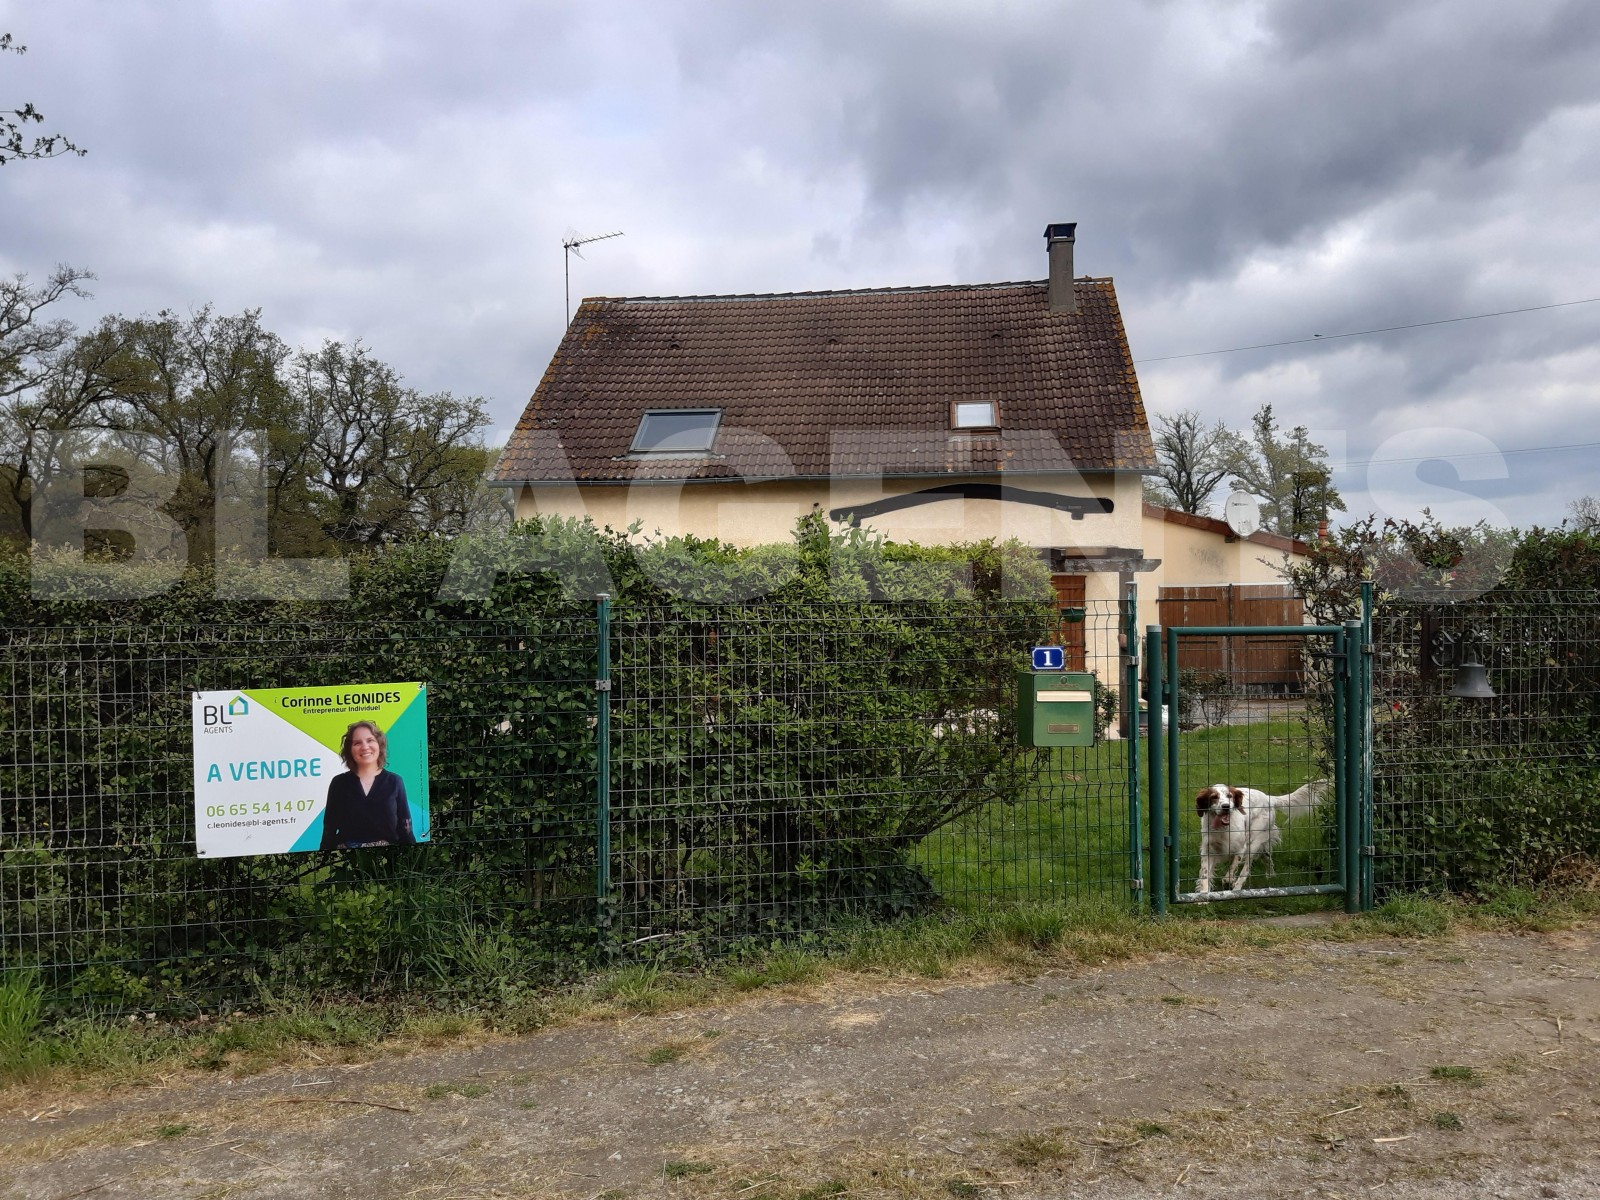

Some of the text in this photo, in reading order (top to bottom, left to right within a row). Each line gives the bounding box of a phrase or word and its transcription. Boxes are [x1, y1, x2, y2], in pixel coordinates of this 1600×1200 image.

[1043, 650, 1053, 666] 1
[281, 691, 401, 708] Corinne LEONIDES
[204, 705, 233, 726] BL
[303, 704, 381, 715] Entrepreneur Individuel
[204, 725, 233, 735] AGENTS
[207, 758, 322, 783] A VENDRE
[206, 799, 315, 817] 06 65 54 14 07
[207, 816, 297, 829] c.leonides@bl-agents.fr
